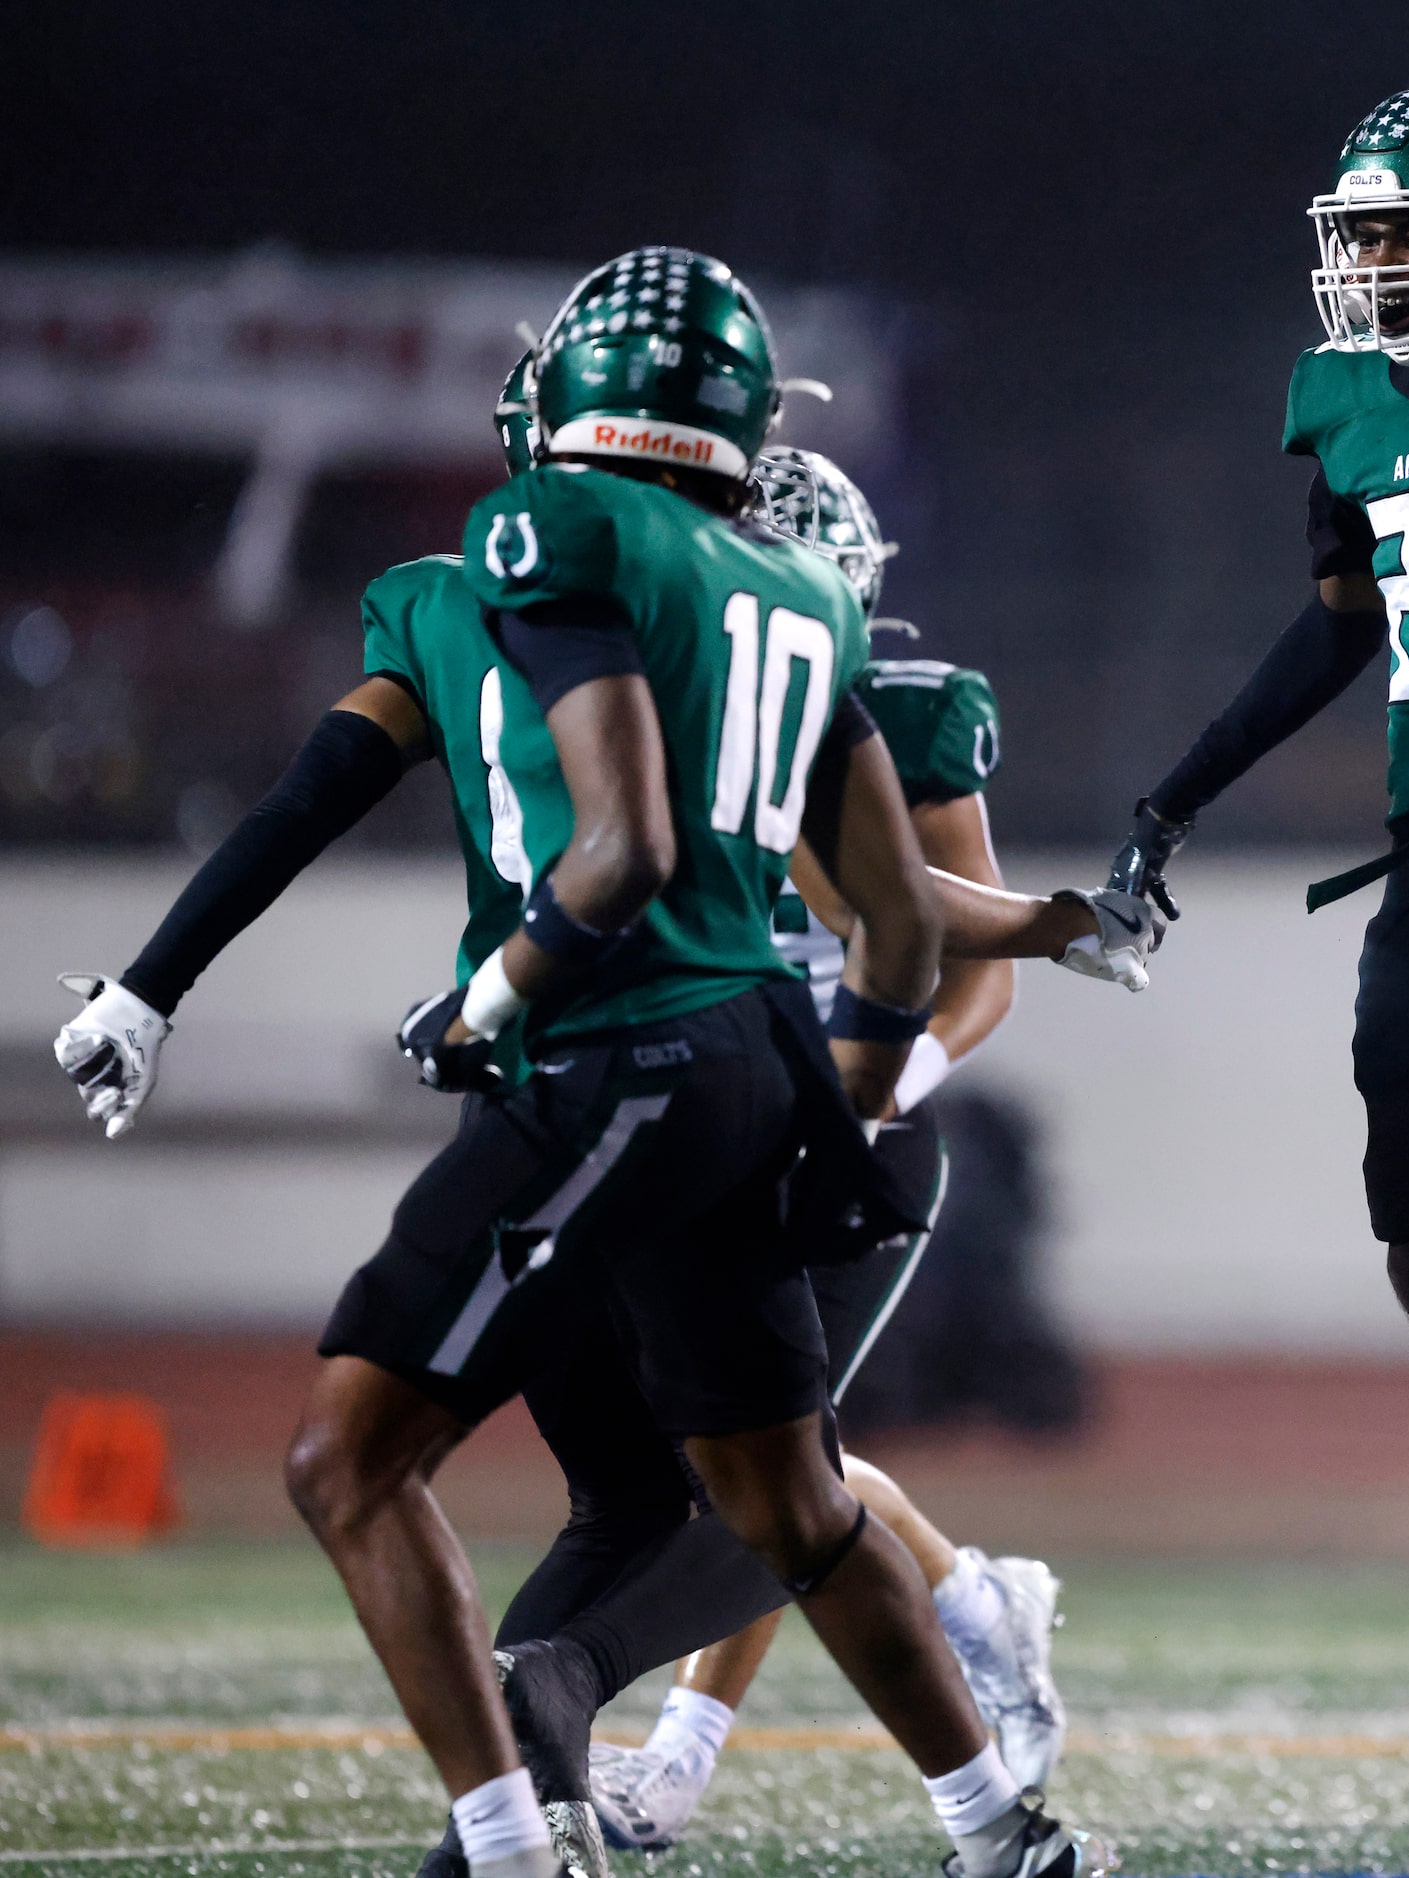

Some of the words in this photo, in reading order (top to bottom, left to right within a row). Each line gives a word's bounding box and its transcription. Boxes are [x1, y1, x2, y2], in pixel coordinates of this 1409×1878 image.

[1349, 174, 1383, 185] COLTS
[653, 342, 683, 368] 10
[593, 425, 715, 465] Riddell
[710, 592, 835, 856] 10
